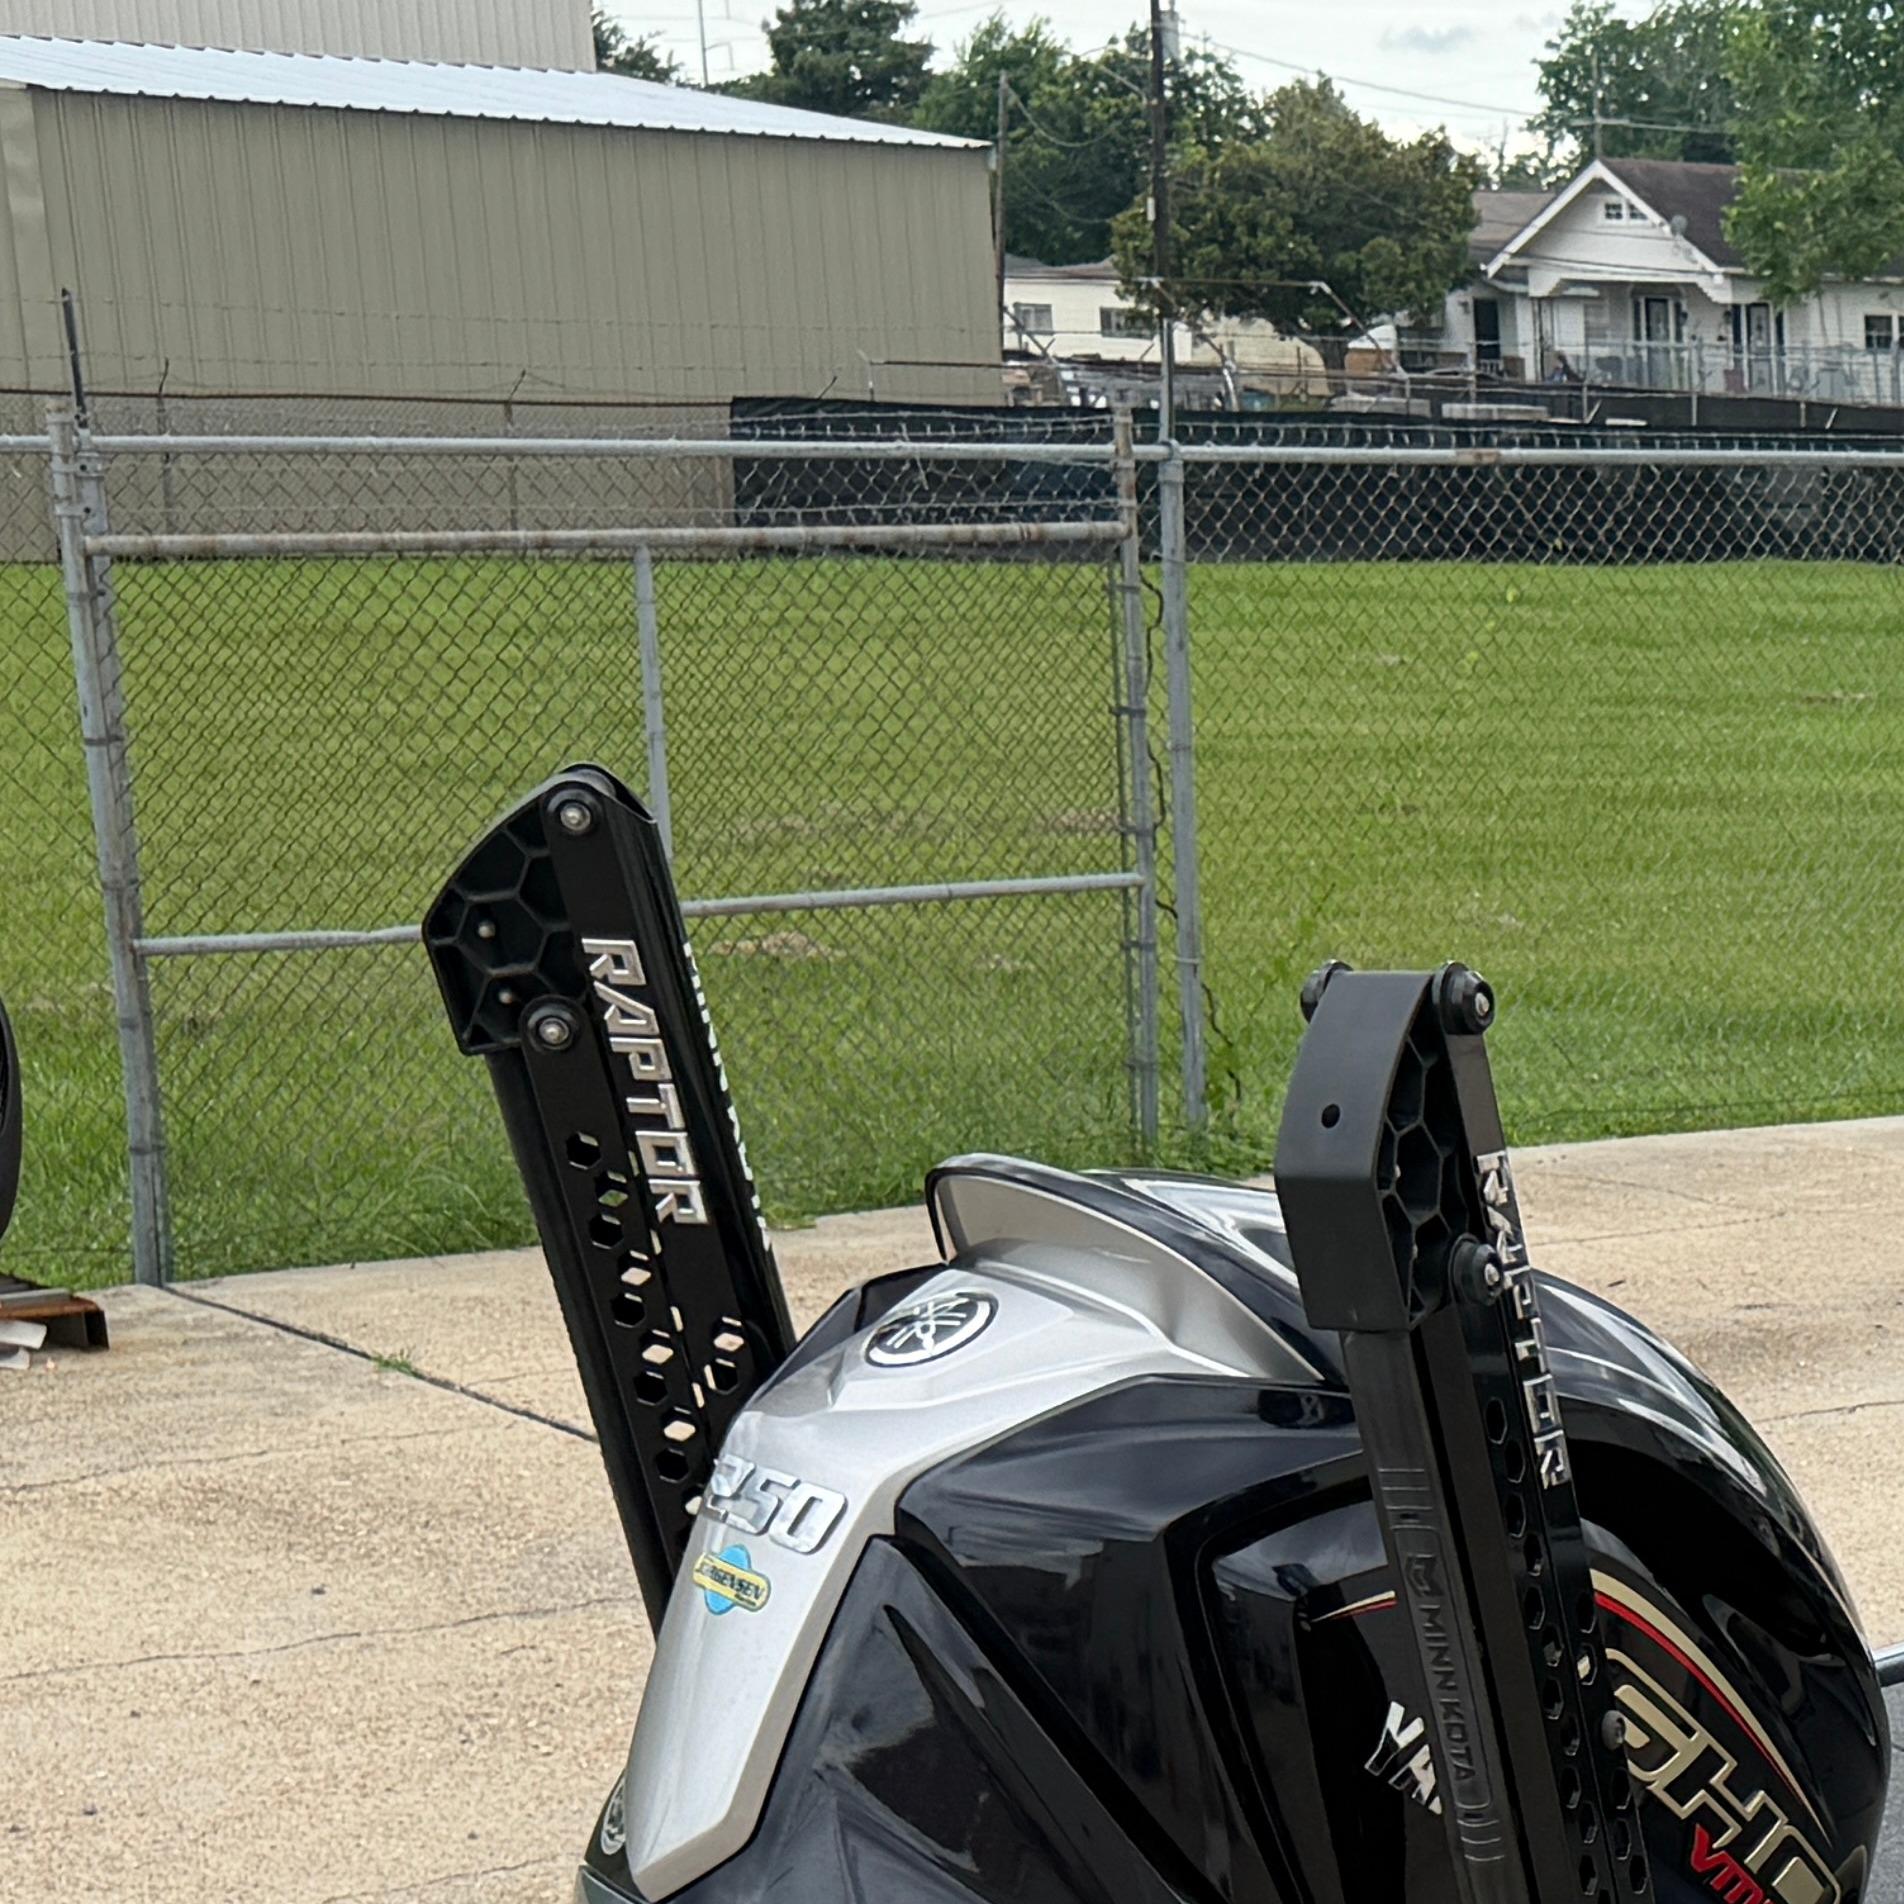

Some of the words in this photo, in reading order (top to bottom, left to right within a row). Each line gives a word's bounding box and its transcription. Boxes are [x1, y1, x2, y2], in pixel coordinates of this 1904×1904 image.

[580, 936, 710, 1226] RAPTOR
[705, 1453, 846, 1554] 250
[1415, 1603, 1463, 1696] MINN
[1439, 1690, 1479, 1785] KOTA
